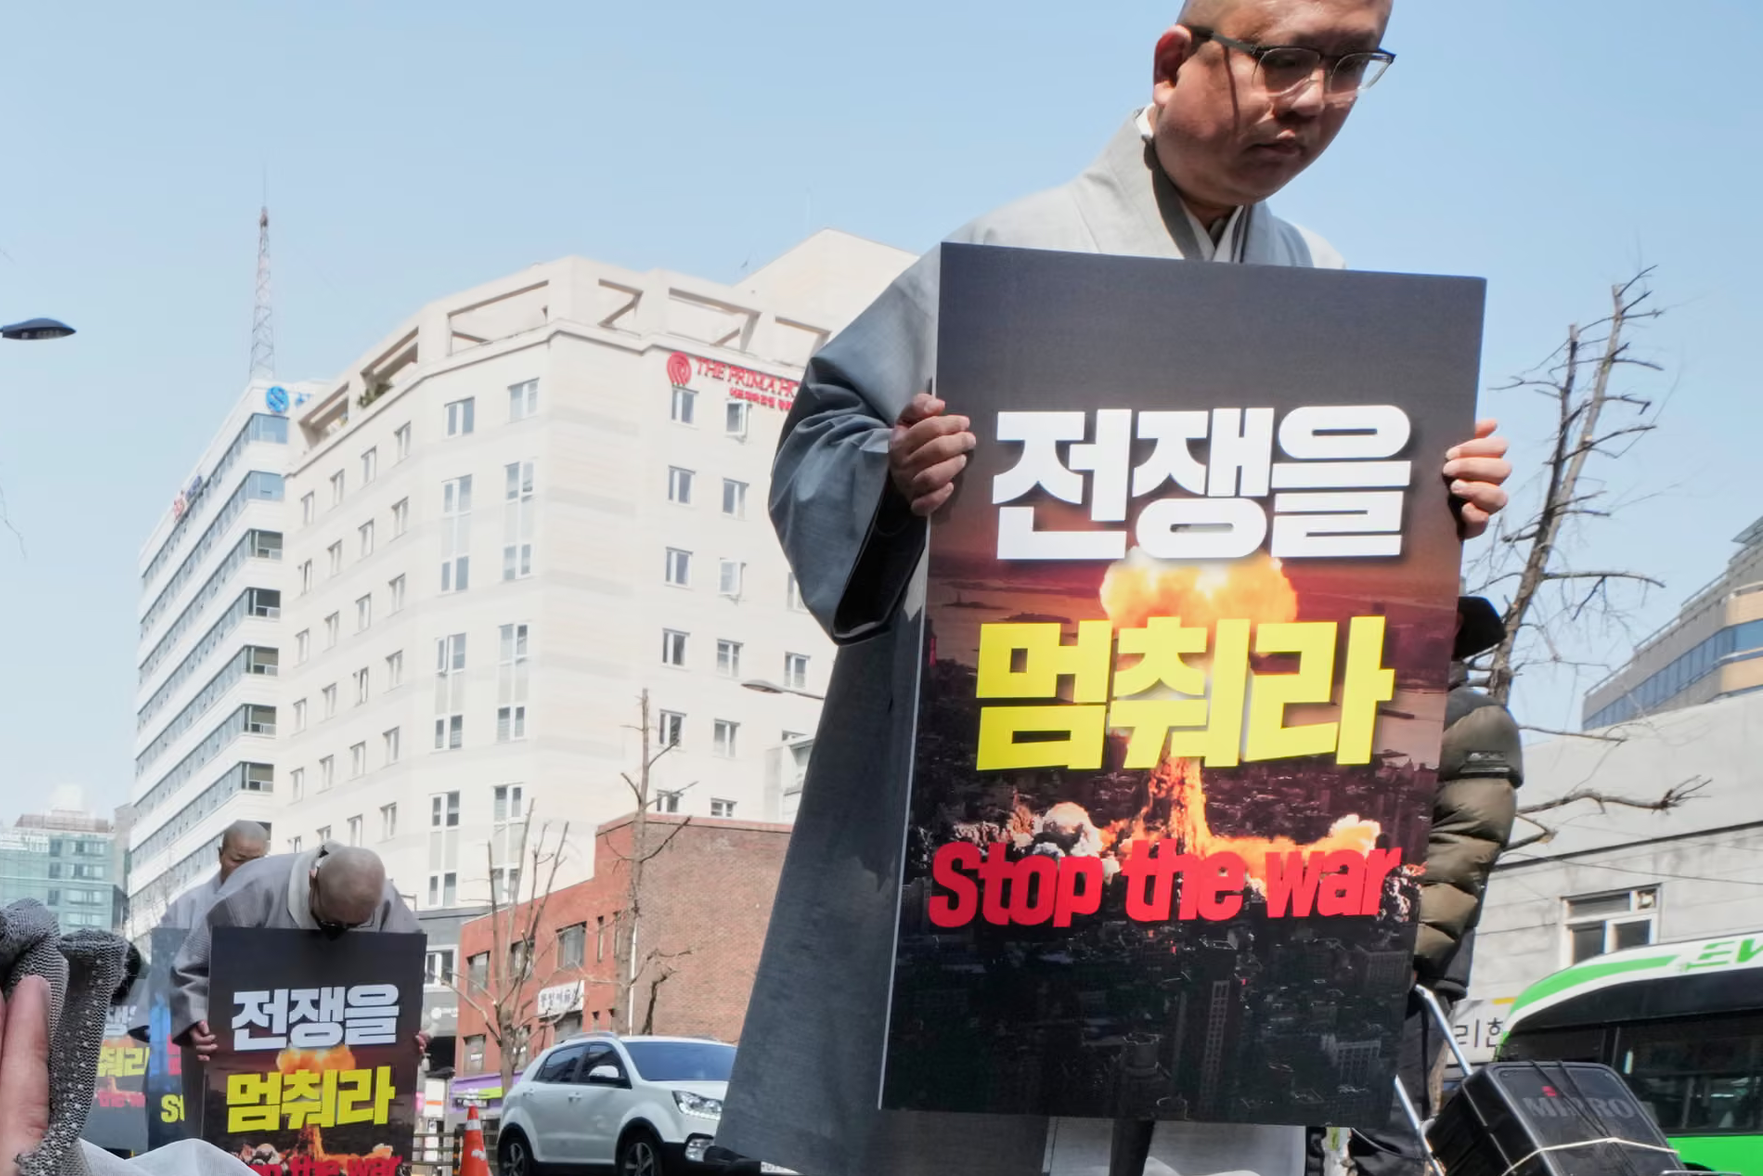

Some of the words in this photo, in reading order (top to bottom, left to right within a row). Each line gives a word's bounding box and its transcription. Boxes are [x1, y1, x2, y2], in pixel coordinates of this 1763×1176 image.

[695, 355, 725, 381] THE
[727, 364, 777, 395] PRIMA
[992, 404, 1412, 561] 전쟁을
[974, 615, 1396, 771] 멈춰라
[928, 840, 1105, 929] Stop
[1123, 838, 1249, 923] the
[1264, 846, 1404, 919] war
[231, 984, 399, 1051] 전쟁을
[226, 1066, 396, 1133] 멈춰라
